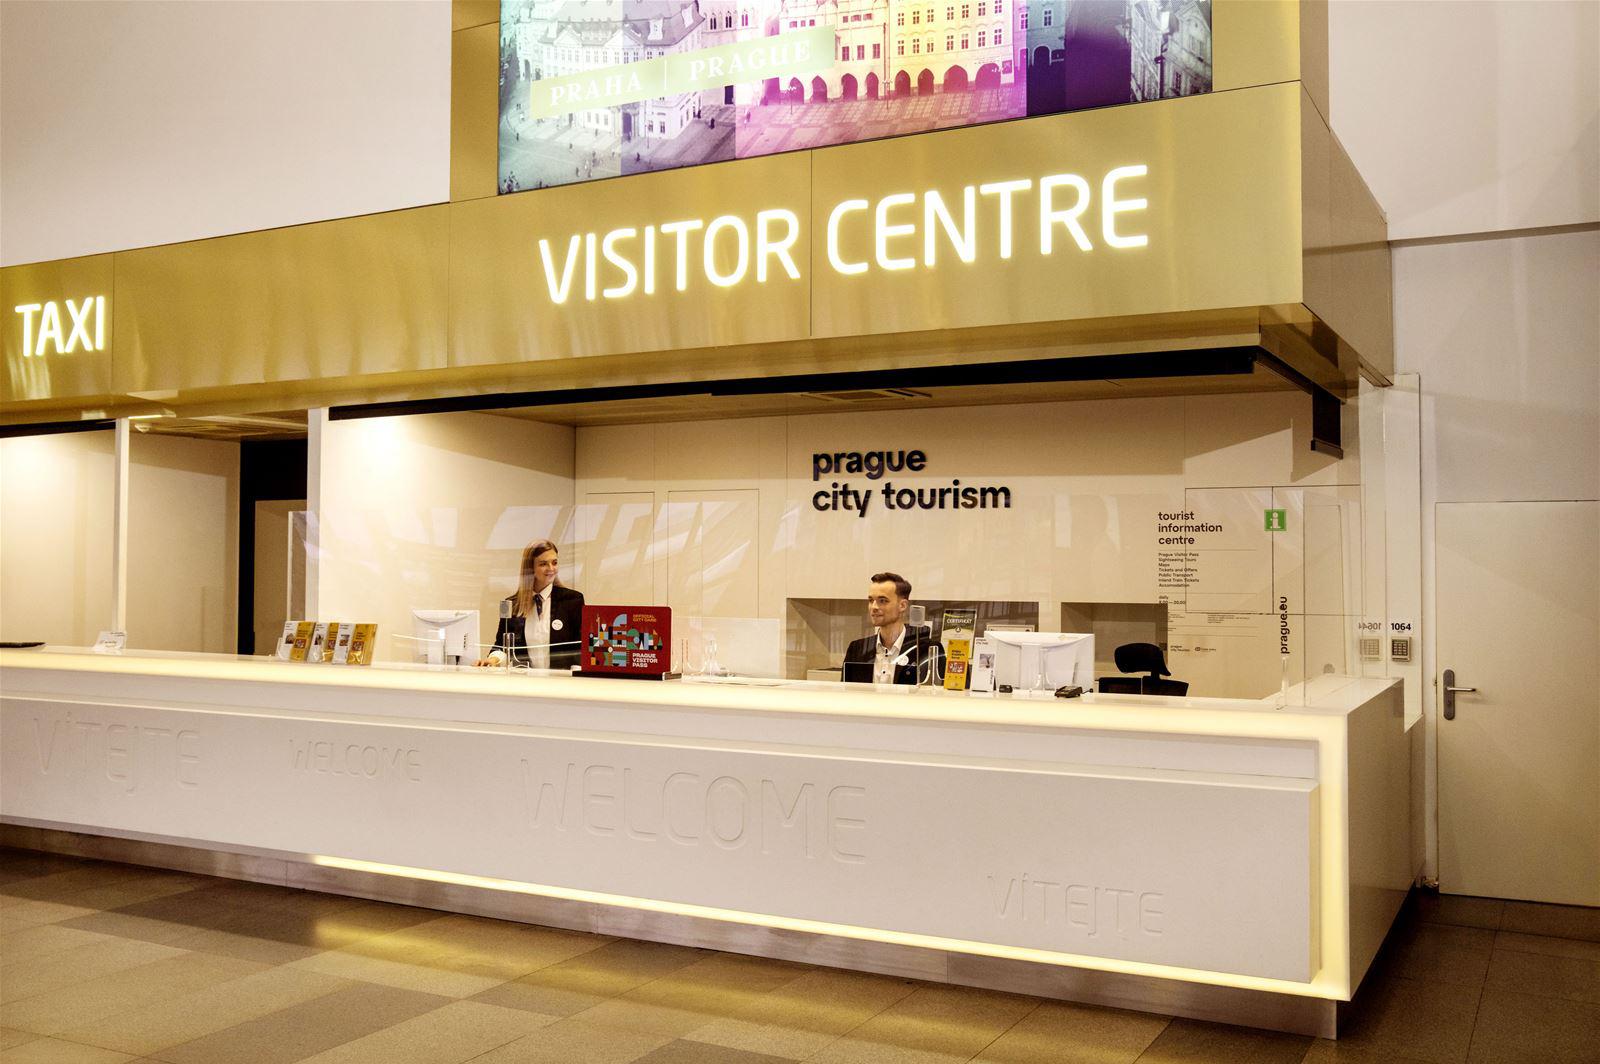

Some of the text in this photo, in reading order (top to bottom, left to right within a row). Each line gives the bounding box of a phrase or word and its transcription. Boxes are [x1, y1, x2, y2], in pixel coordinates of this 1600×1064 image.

[550, 40, 811, 106] PRAHA PRAGUE
[538, 165, 1149, 304] VISITOR CENTRE
[14, 295, 105, 357] TAXI
[812, 450, 927, 481] prague
[812, 479, 1011, 517] city tourism
[1158, 511, 1195, 521] tourist
[1158, 523, 1223, 533] information
[1158, 536, 1195, 544] centre
[1280, 596, 1290, 654] prague.eu
[288, 738, 421, 783] WELCOME
[520, 758, 866, 865] WELCOME
